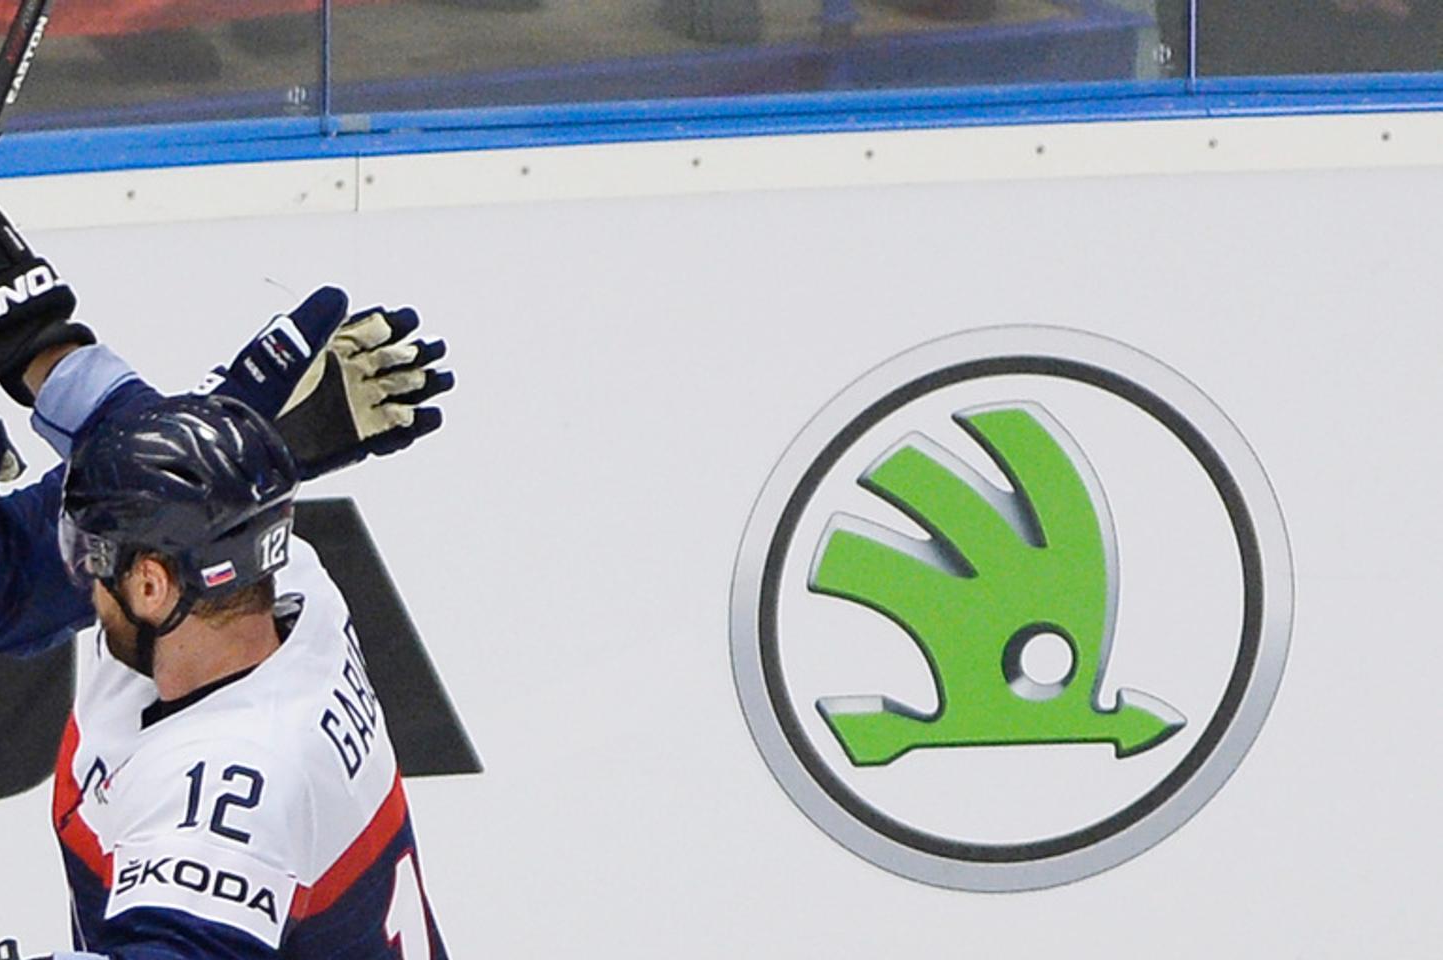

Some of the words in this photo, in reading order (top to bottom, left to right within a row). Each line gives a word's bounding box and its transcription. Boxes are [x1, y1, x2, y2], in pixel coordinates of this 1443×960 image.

[5, 15, 48, 104] EASTON
[260, 525, 286, 570] 12
[177, 760, 265, 845] 12
[115, 857, 278, 925] ŠKODA
